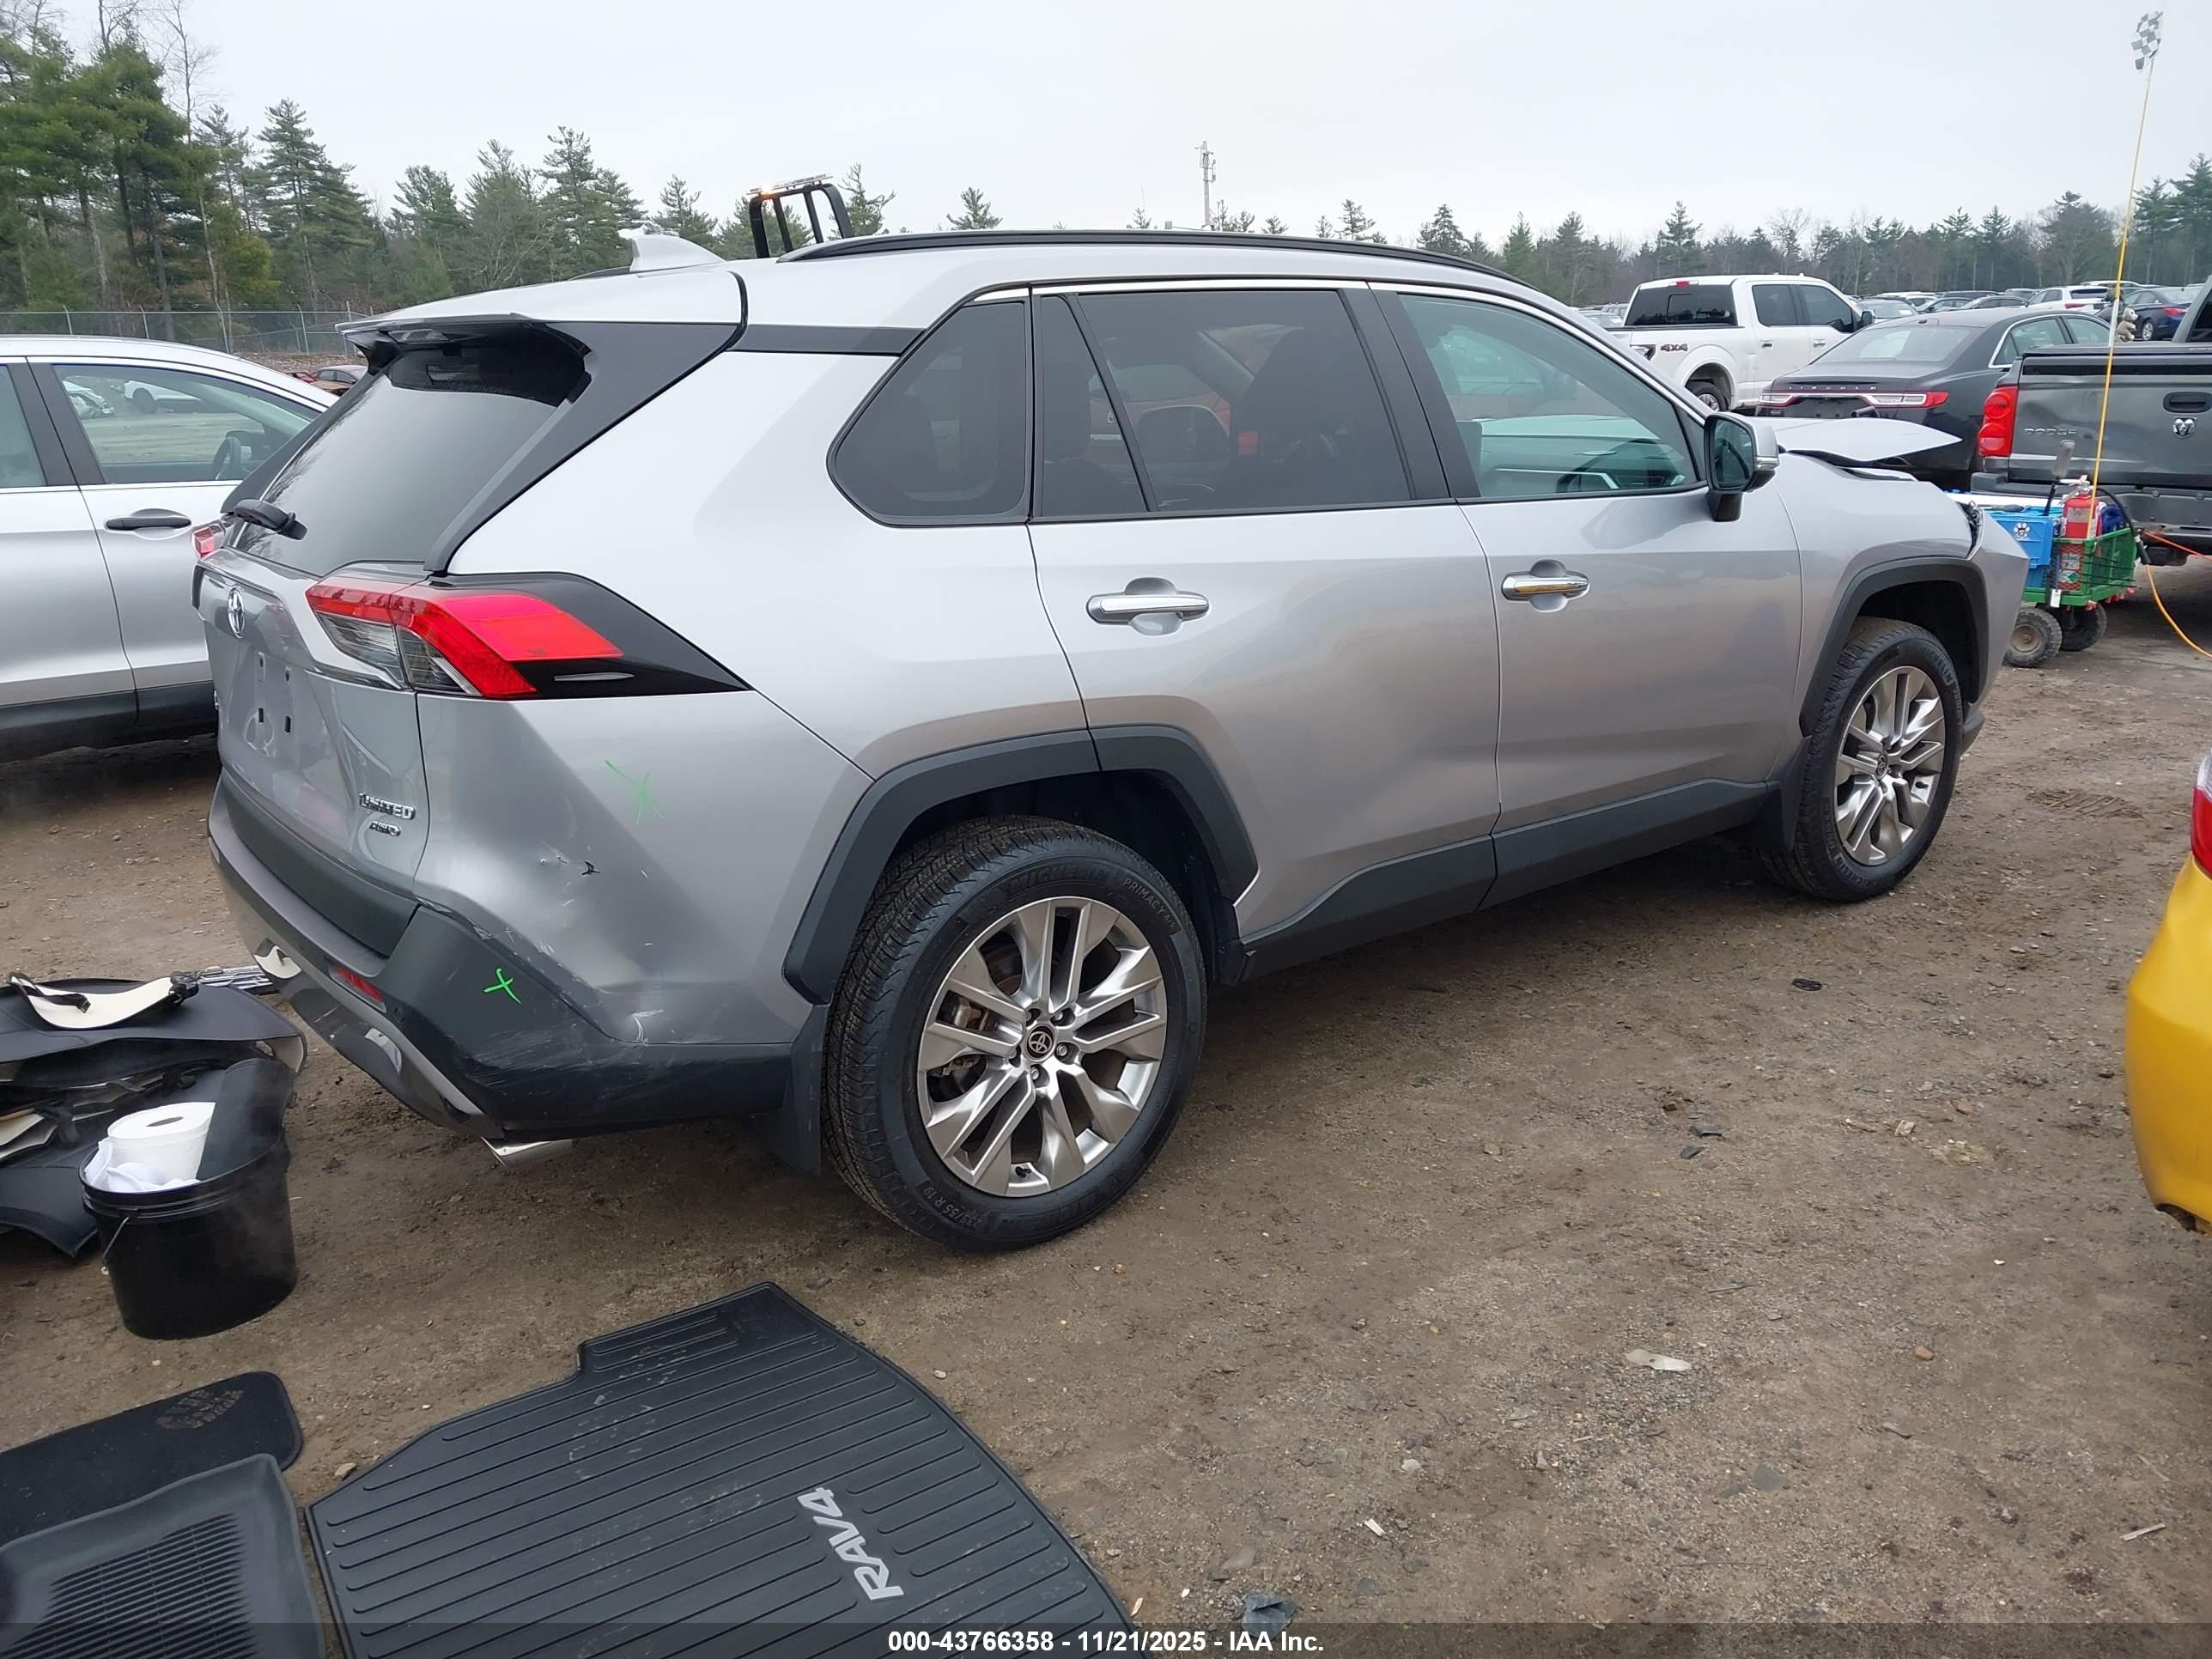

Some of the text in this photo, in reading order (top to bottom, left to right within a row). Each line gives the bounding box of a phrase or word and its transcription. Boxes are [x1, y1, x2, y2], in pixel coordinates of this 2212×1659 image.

[2023, 428, 2077, 436] DODGE
[1123, 878, 1165, 915] PRIMACY
[797, 1487, 904, 1601] RAV4
